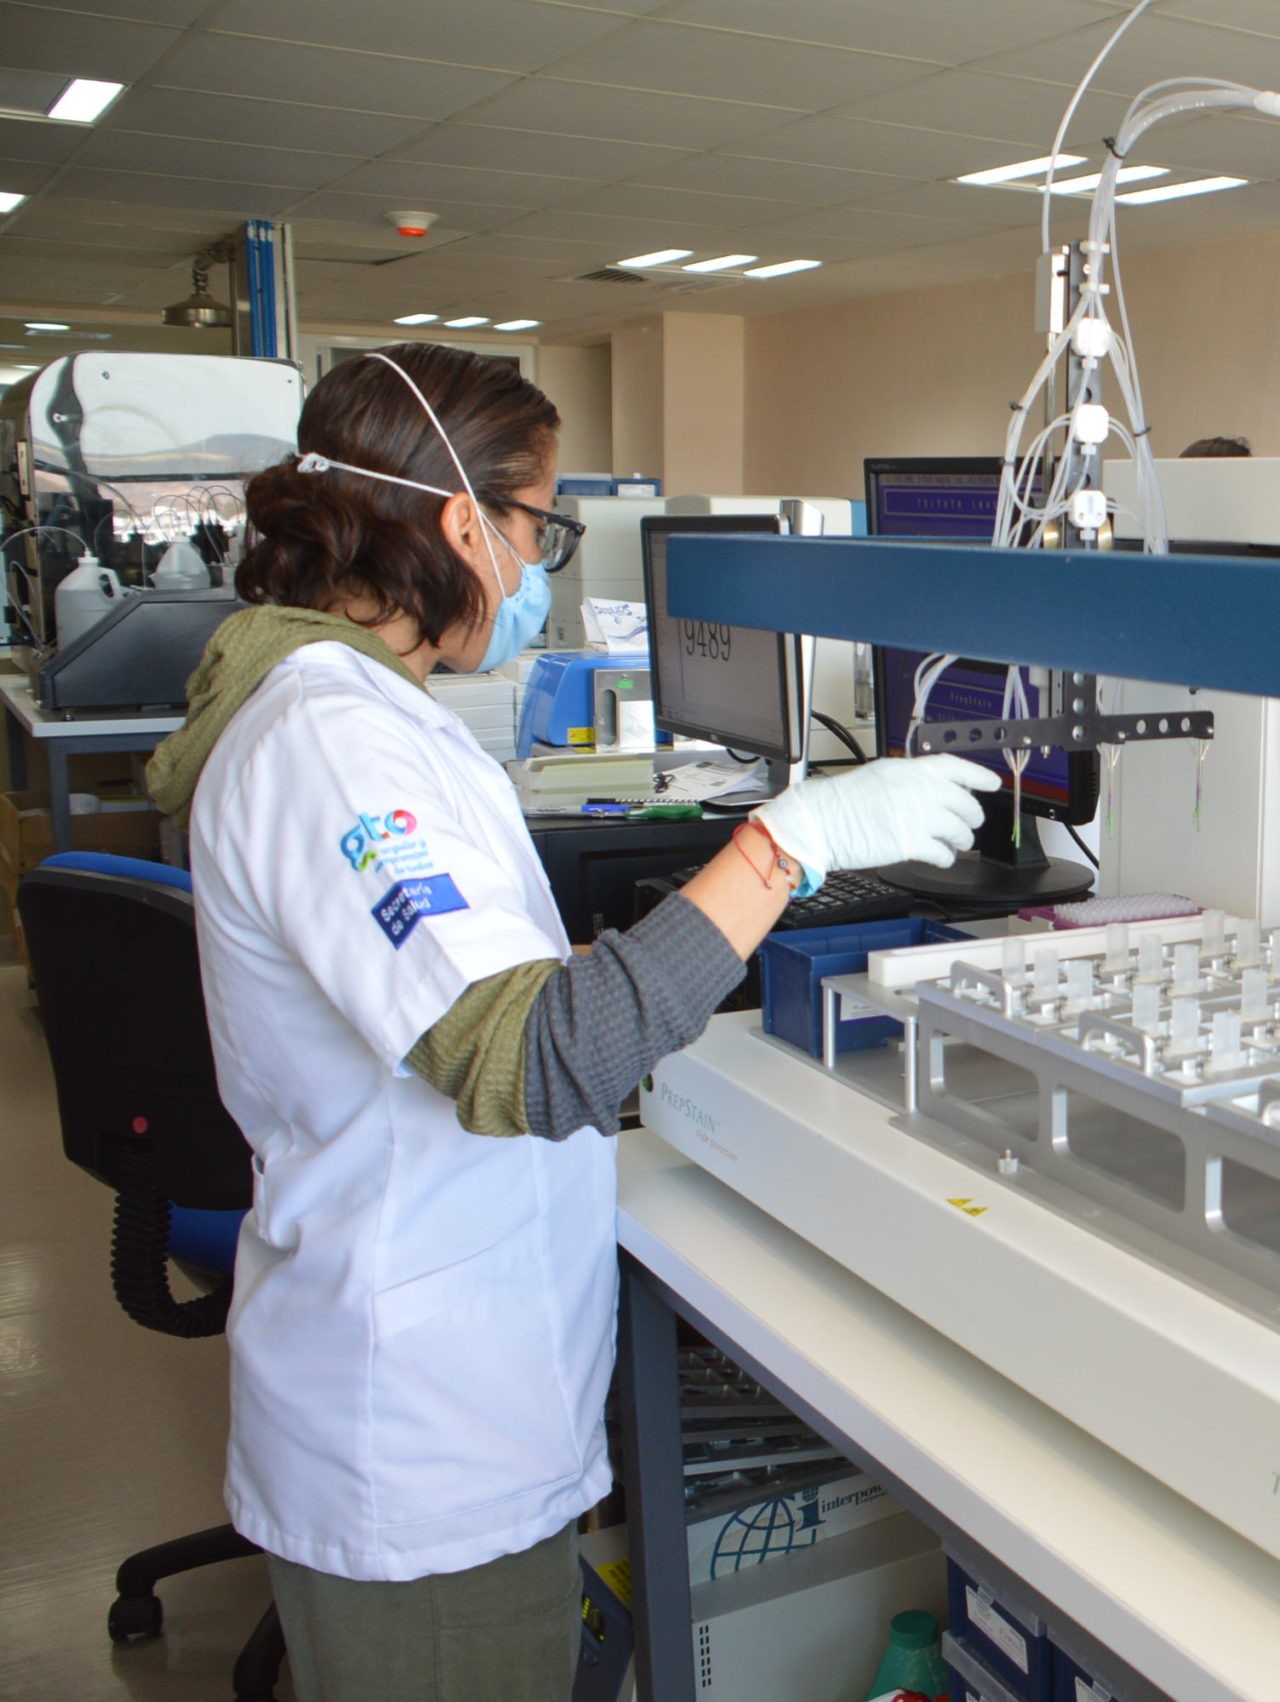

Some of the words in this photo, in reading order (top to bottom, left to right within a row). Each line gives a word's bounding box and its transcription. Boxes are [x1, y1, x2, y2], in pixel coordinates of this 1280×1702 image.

[684, 619, 732, 662] 9489
[380, 882, 432, 922] Secretaría
[391, 919, 404, 936] de
[401, 897, 432, 921] Salud
[822, 1484, 883, 1513] interpow
